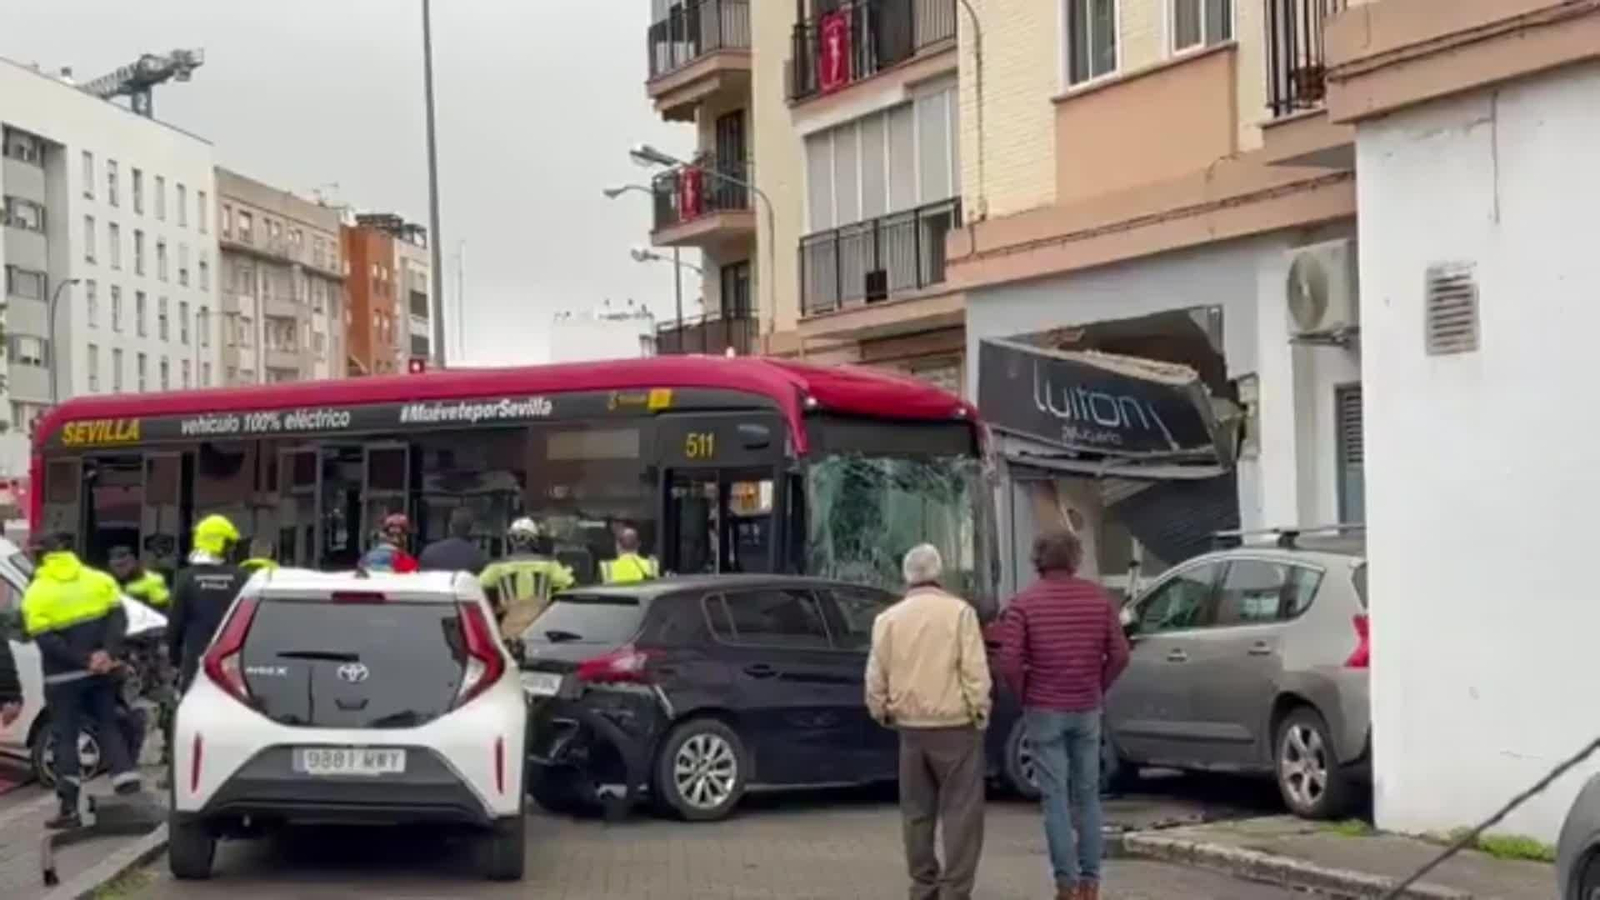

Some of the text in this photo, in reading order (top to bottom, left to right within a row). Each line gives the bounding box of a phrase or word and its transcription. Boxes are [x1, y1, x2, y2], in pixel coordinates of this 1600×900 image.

[62, 418, 141, 446] SEVILLA
[243, 411, 281, 431] 100%
[284, 408, 351, 430] eléctrico
[685, 431, 715, 459] 511
